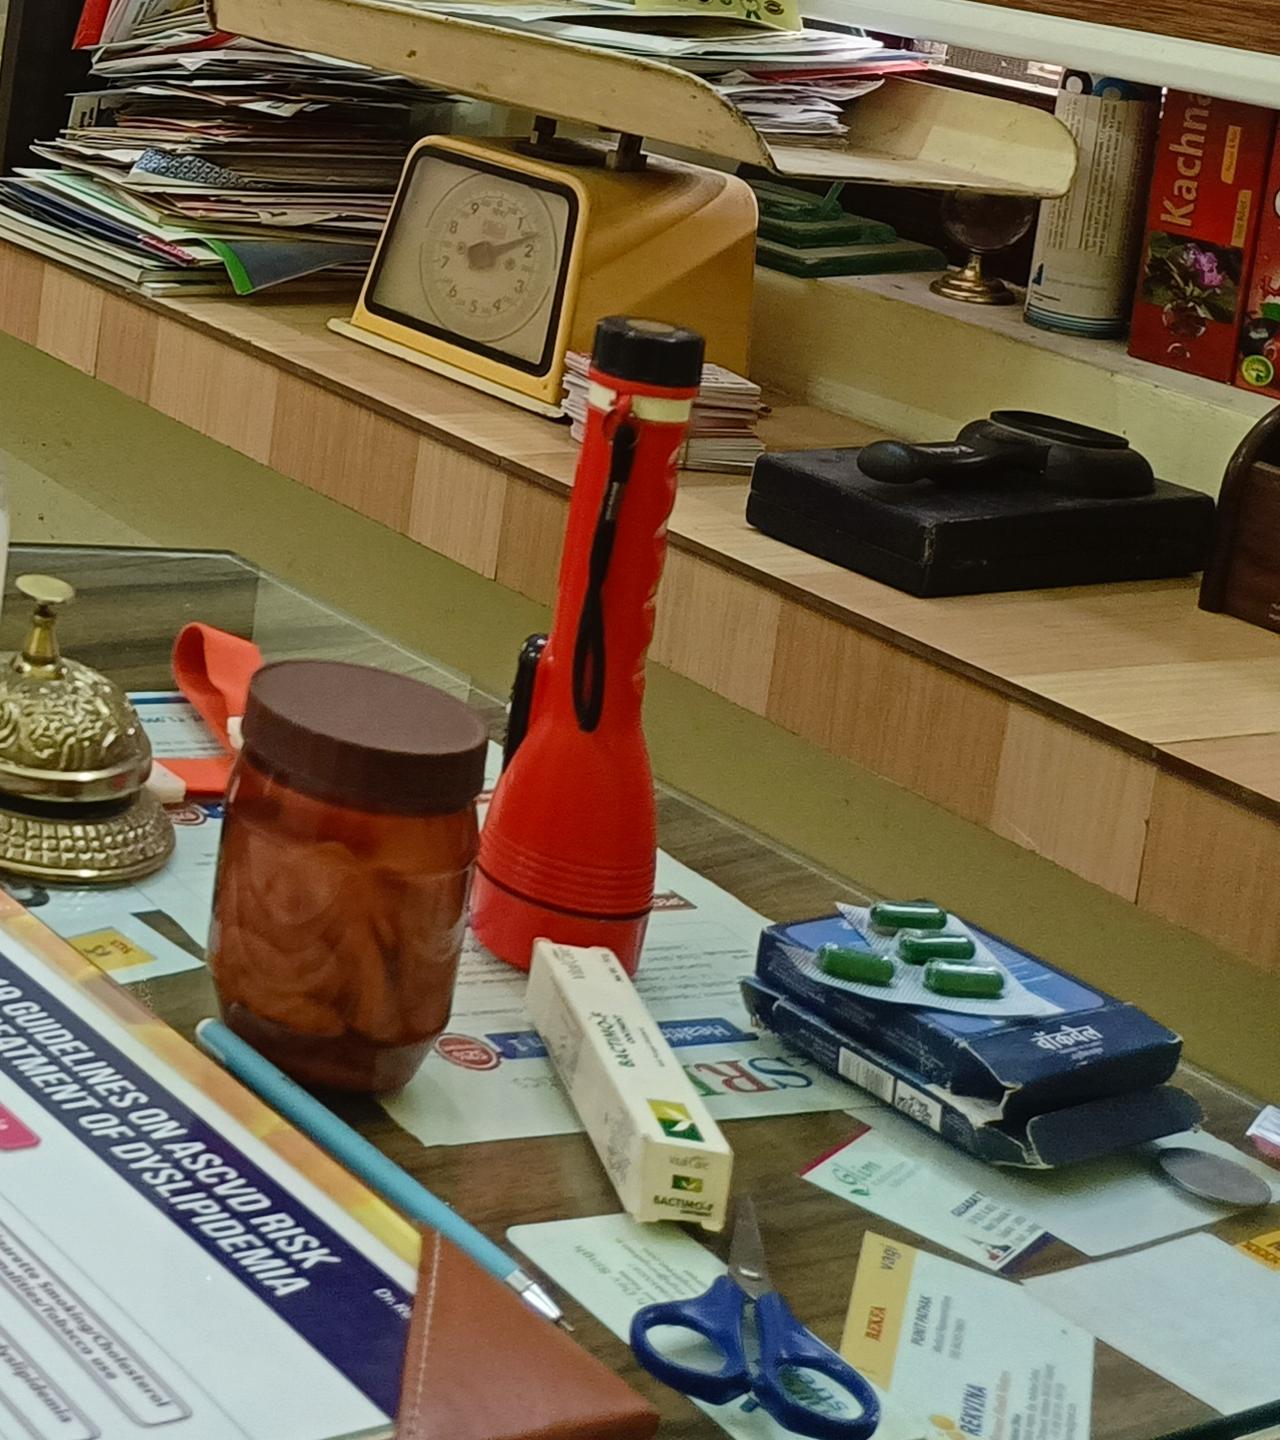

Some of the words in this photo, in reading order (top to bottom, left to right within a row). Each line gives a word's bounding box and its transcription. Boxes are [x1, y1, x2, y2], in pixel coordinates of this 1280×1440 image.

[471, 202, 480, 215] 9
[448, 221, 459, 234] 8
[517, 217, 524, 230] 1
[524, 243, 534, 258] 2
[440, 256, 450, 269] 7
[448, 284, 458, 298] 6
[514, 279, 525, 294] 3
[470, 299, 479, 313] 5
[493, 299, 502, 311] 4
[2, 1001, 148, 1108] GUIDELINES
[128, 1109, 186, 1140] ON
[164, 1141, 272, 1212] ASCVD
[251, 1213, 342, 1269] RISK
[78, 1113, 136, 1140] OF
[111, 1141, 311, 1297] DYSLIPIDEMIA
[39, 1279, 173, 1409] Smoking/Cholesterol
[91, 1355, 118, 1381] use
[960, 1382, 988, 1438] REKVINA
